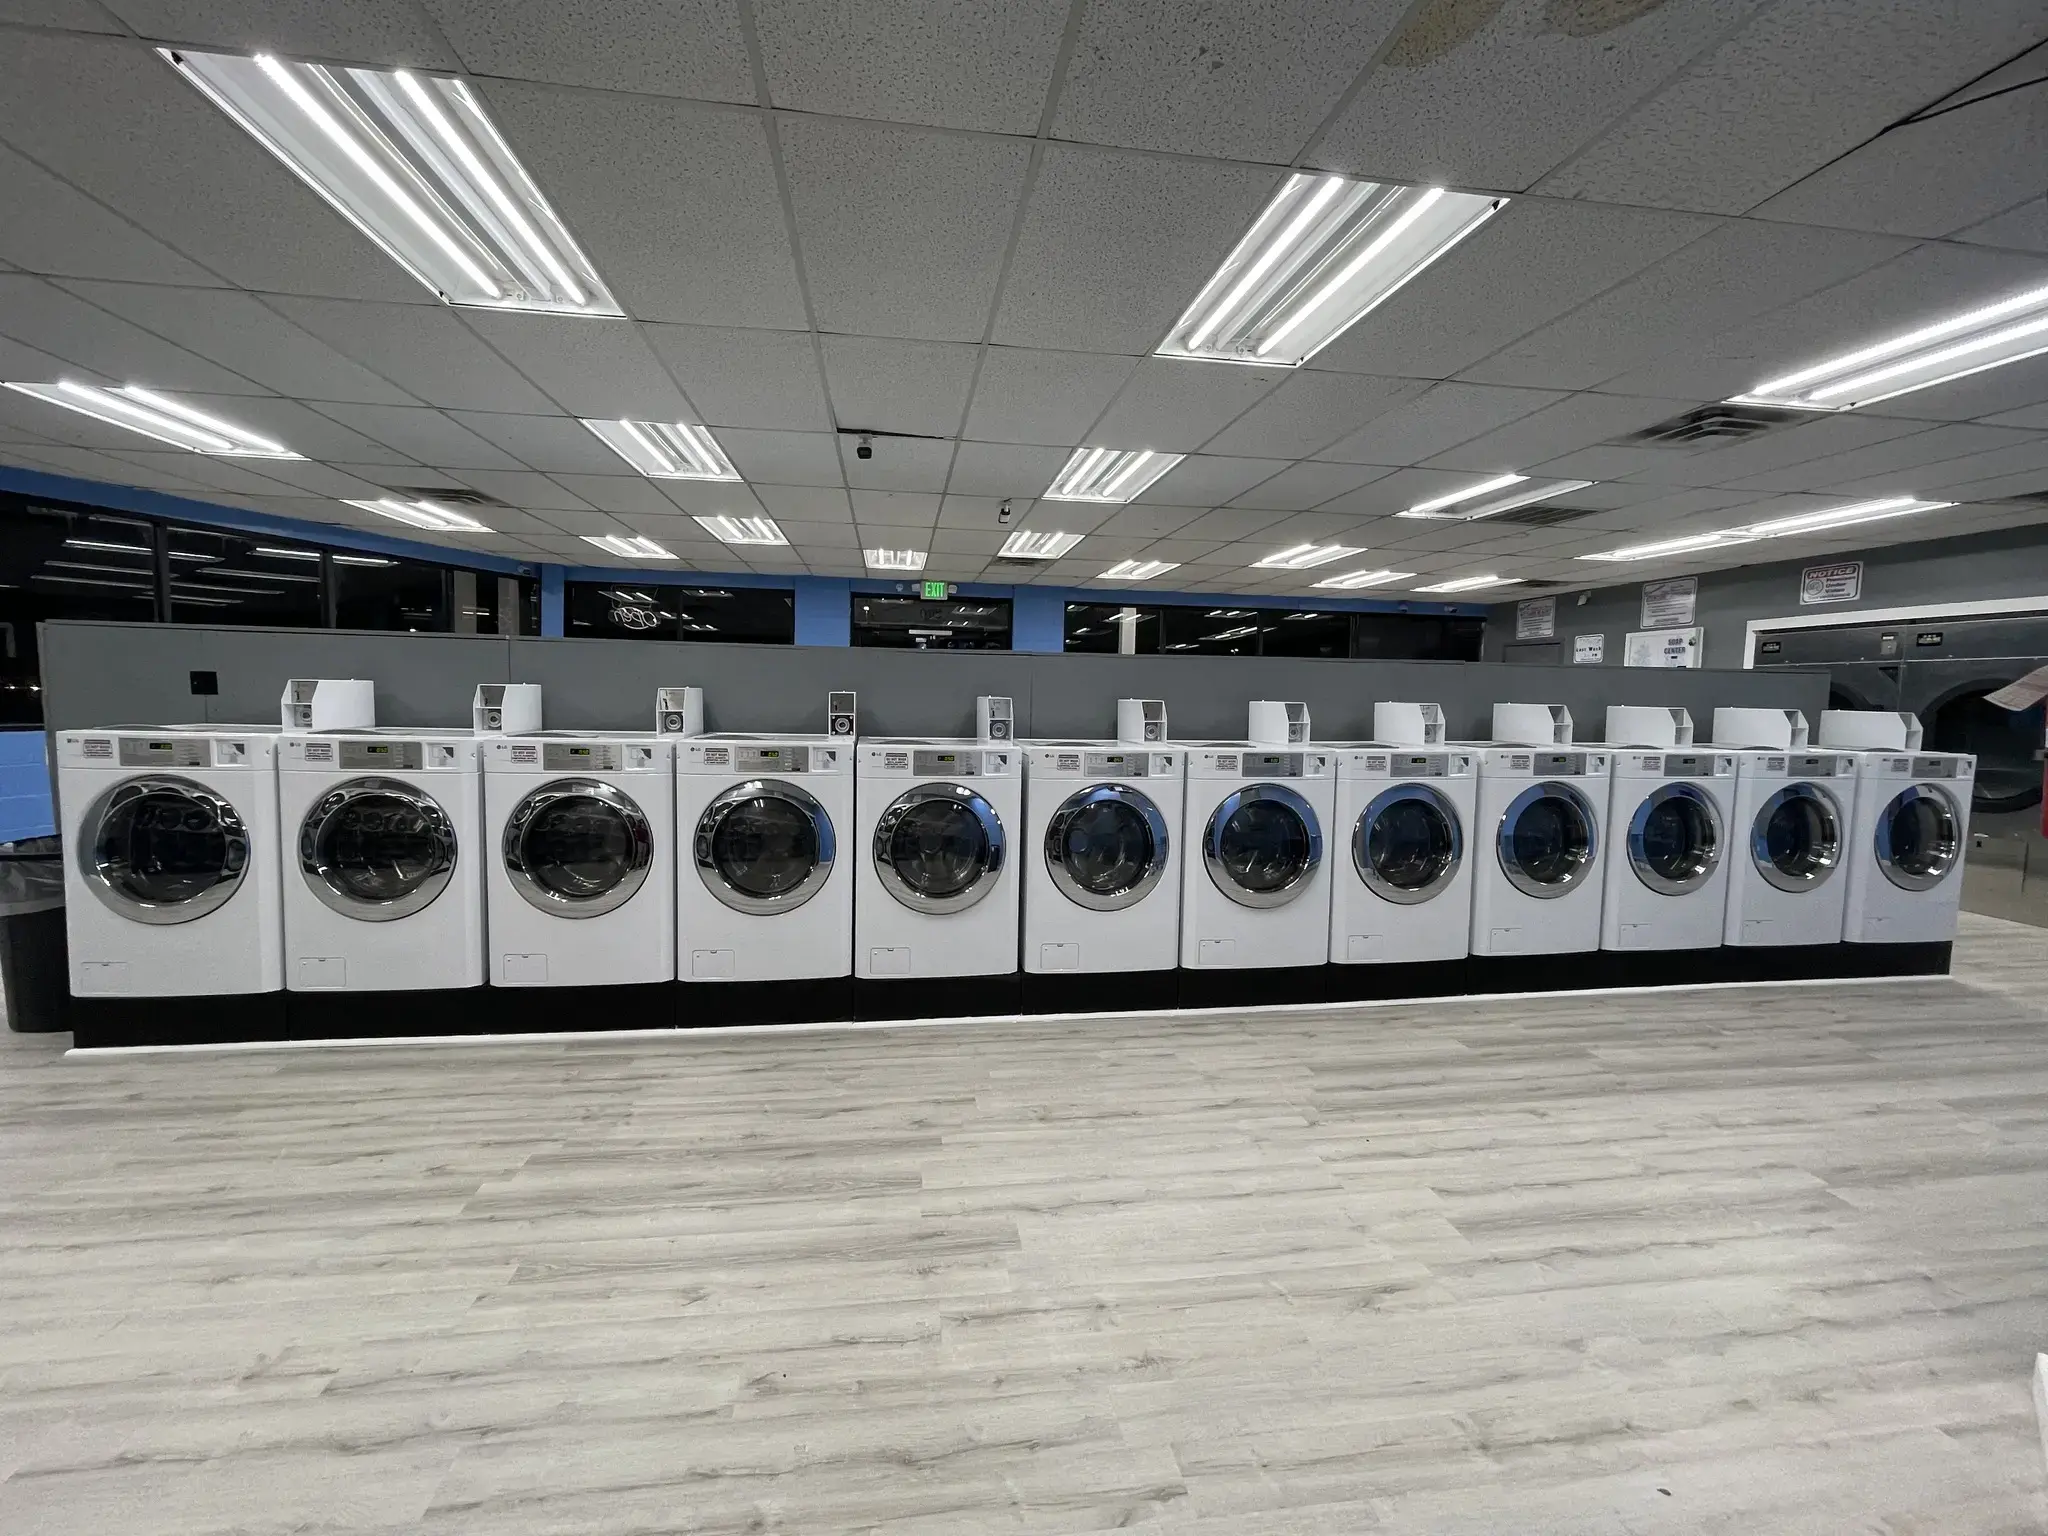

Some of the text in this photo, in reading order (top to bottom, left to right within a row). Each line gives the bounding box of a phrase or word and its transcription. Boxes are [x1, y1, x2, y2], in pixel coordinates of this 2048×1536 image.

[1808, 566, 1854, 579] NOTICE
[925, 582, 945, 597] EXIT
[1667, 638, 1683, 646] SOAP
[1664, 647, 1686, 655] CENTER
